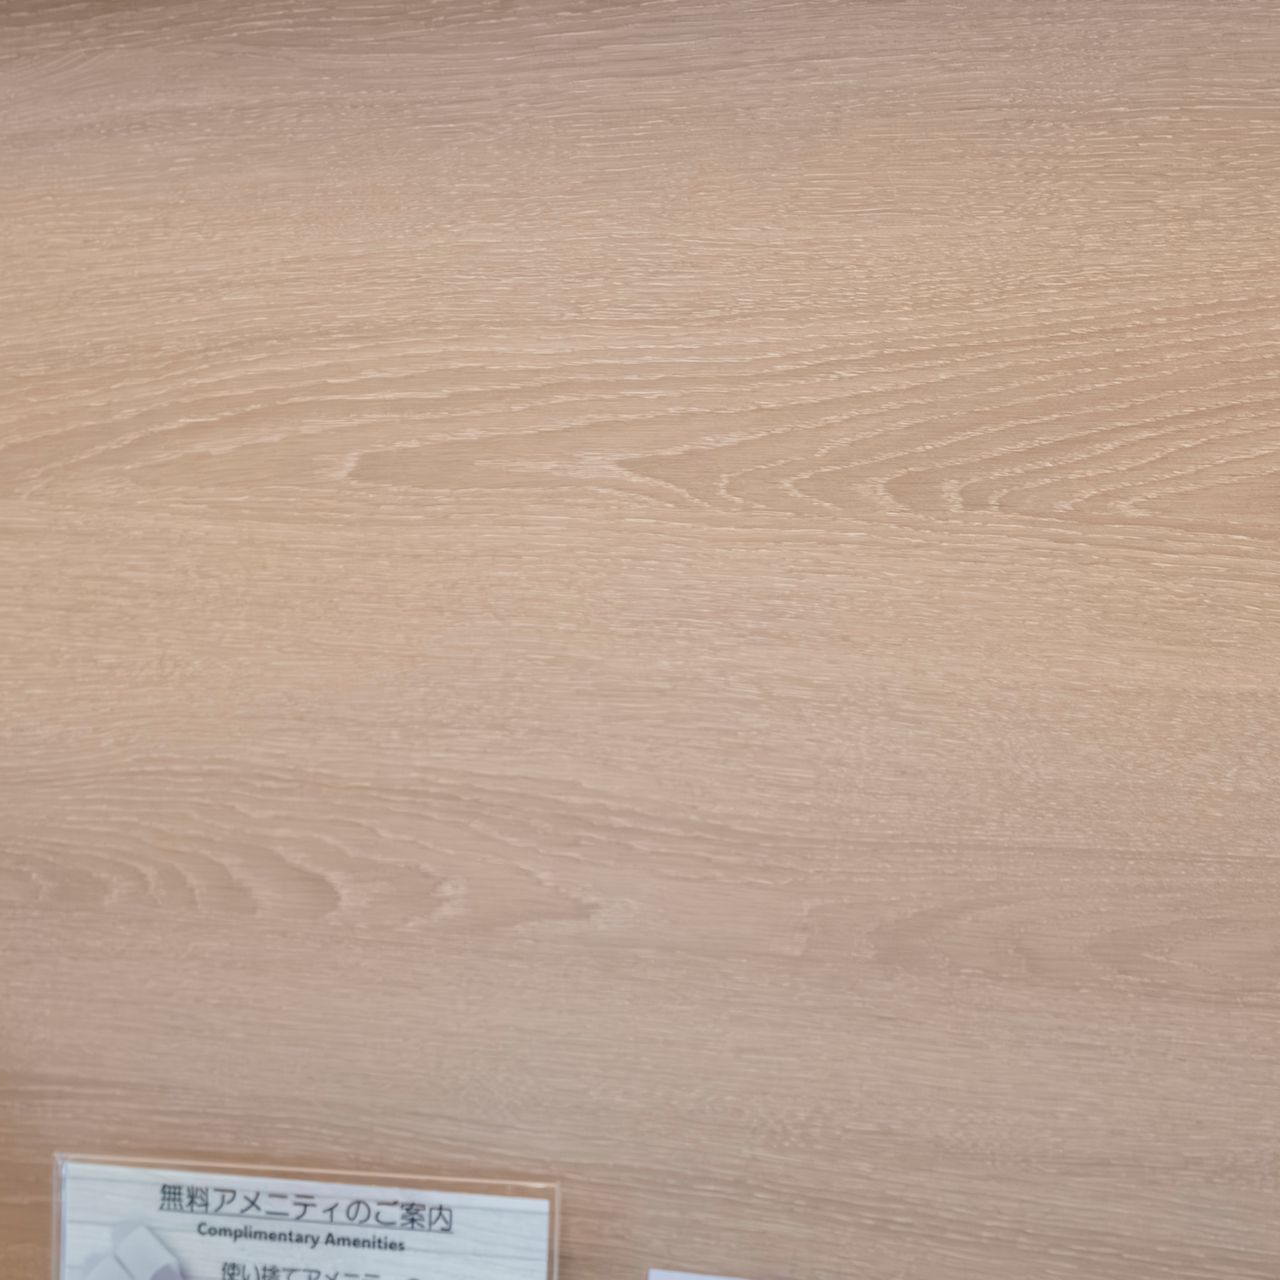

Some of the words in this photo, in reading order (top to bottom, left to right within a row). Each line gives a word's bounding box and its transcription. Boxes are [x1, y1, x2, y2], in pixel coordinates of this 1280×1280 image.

[159, 1183, 453, 1232] 無料アメニティのご案内
[197, 1222, 320, 1248] Complimentary
[325, 1233, 405, 1252] Amenities
